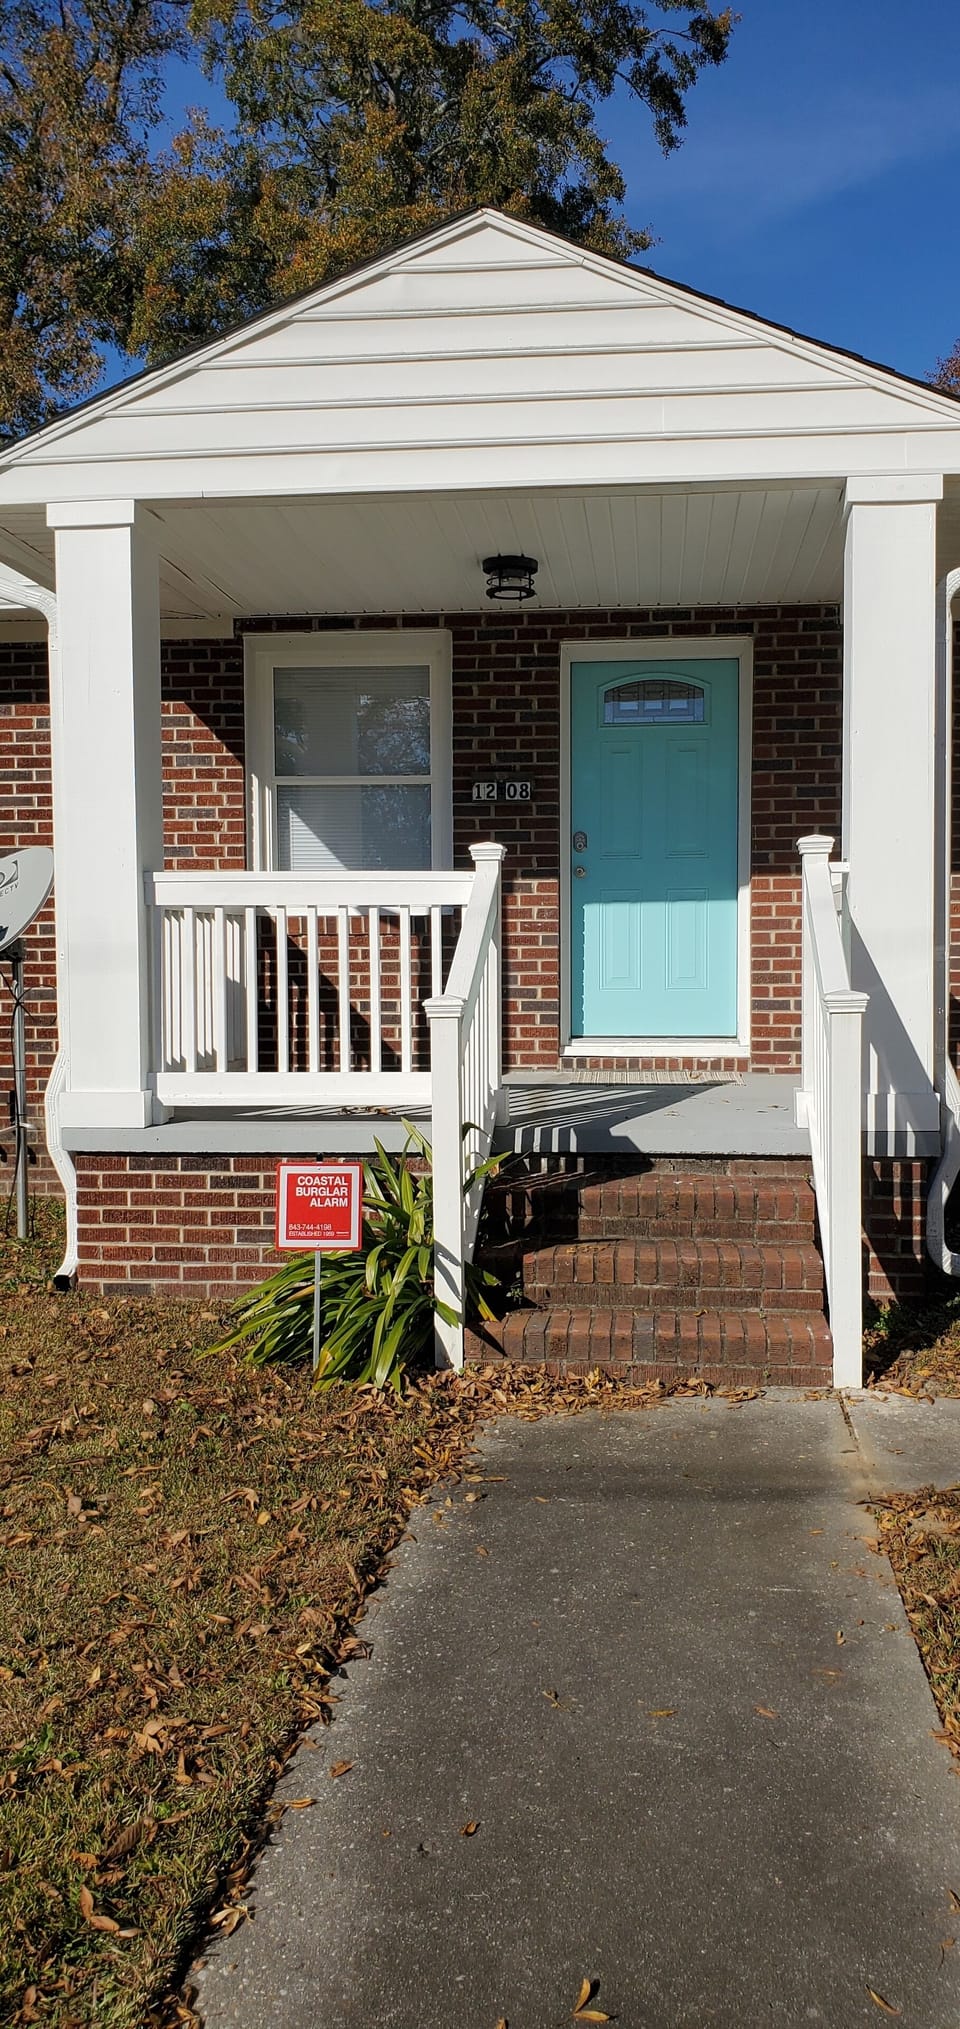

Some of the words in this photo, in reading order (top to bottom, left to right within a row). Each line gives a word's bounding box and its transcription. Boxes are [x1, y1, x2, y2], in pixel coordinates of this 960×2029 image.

[475, 783, 496, 799] 12
[507, 783, 530, 799] 08
[297, 1176, 348, 1185] COASTAL
[295, 1187, 348, 1196] BURGLAR
[310, 1198, 348, 1207] ALARM
